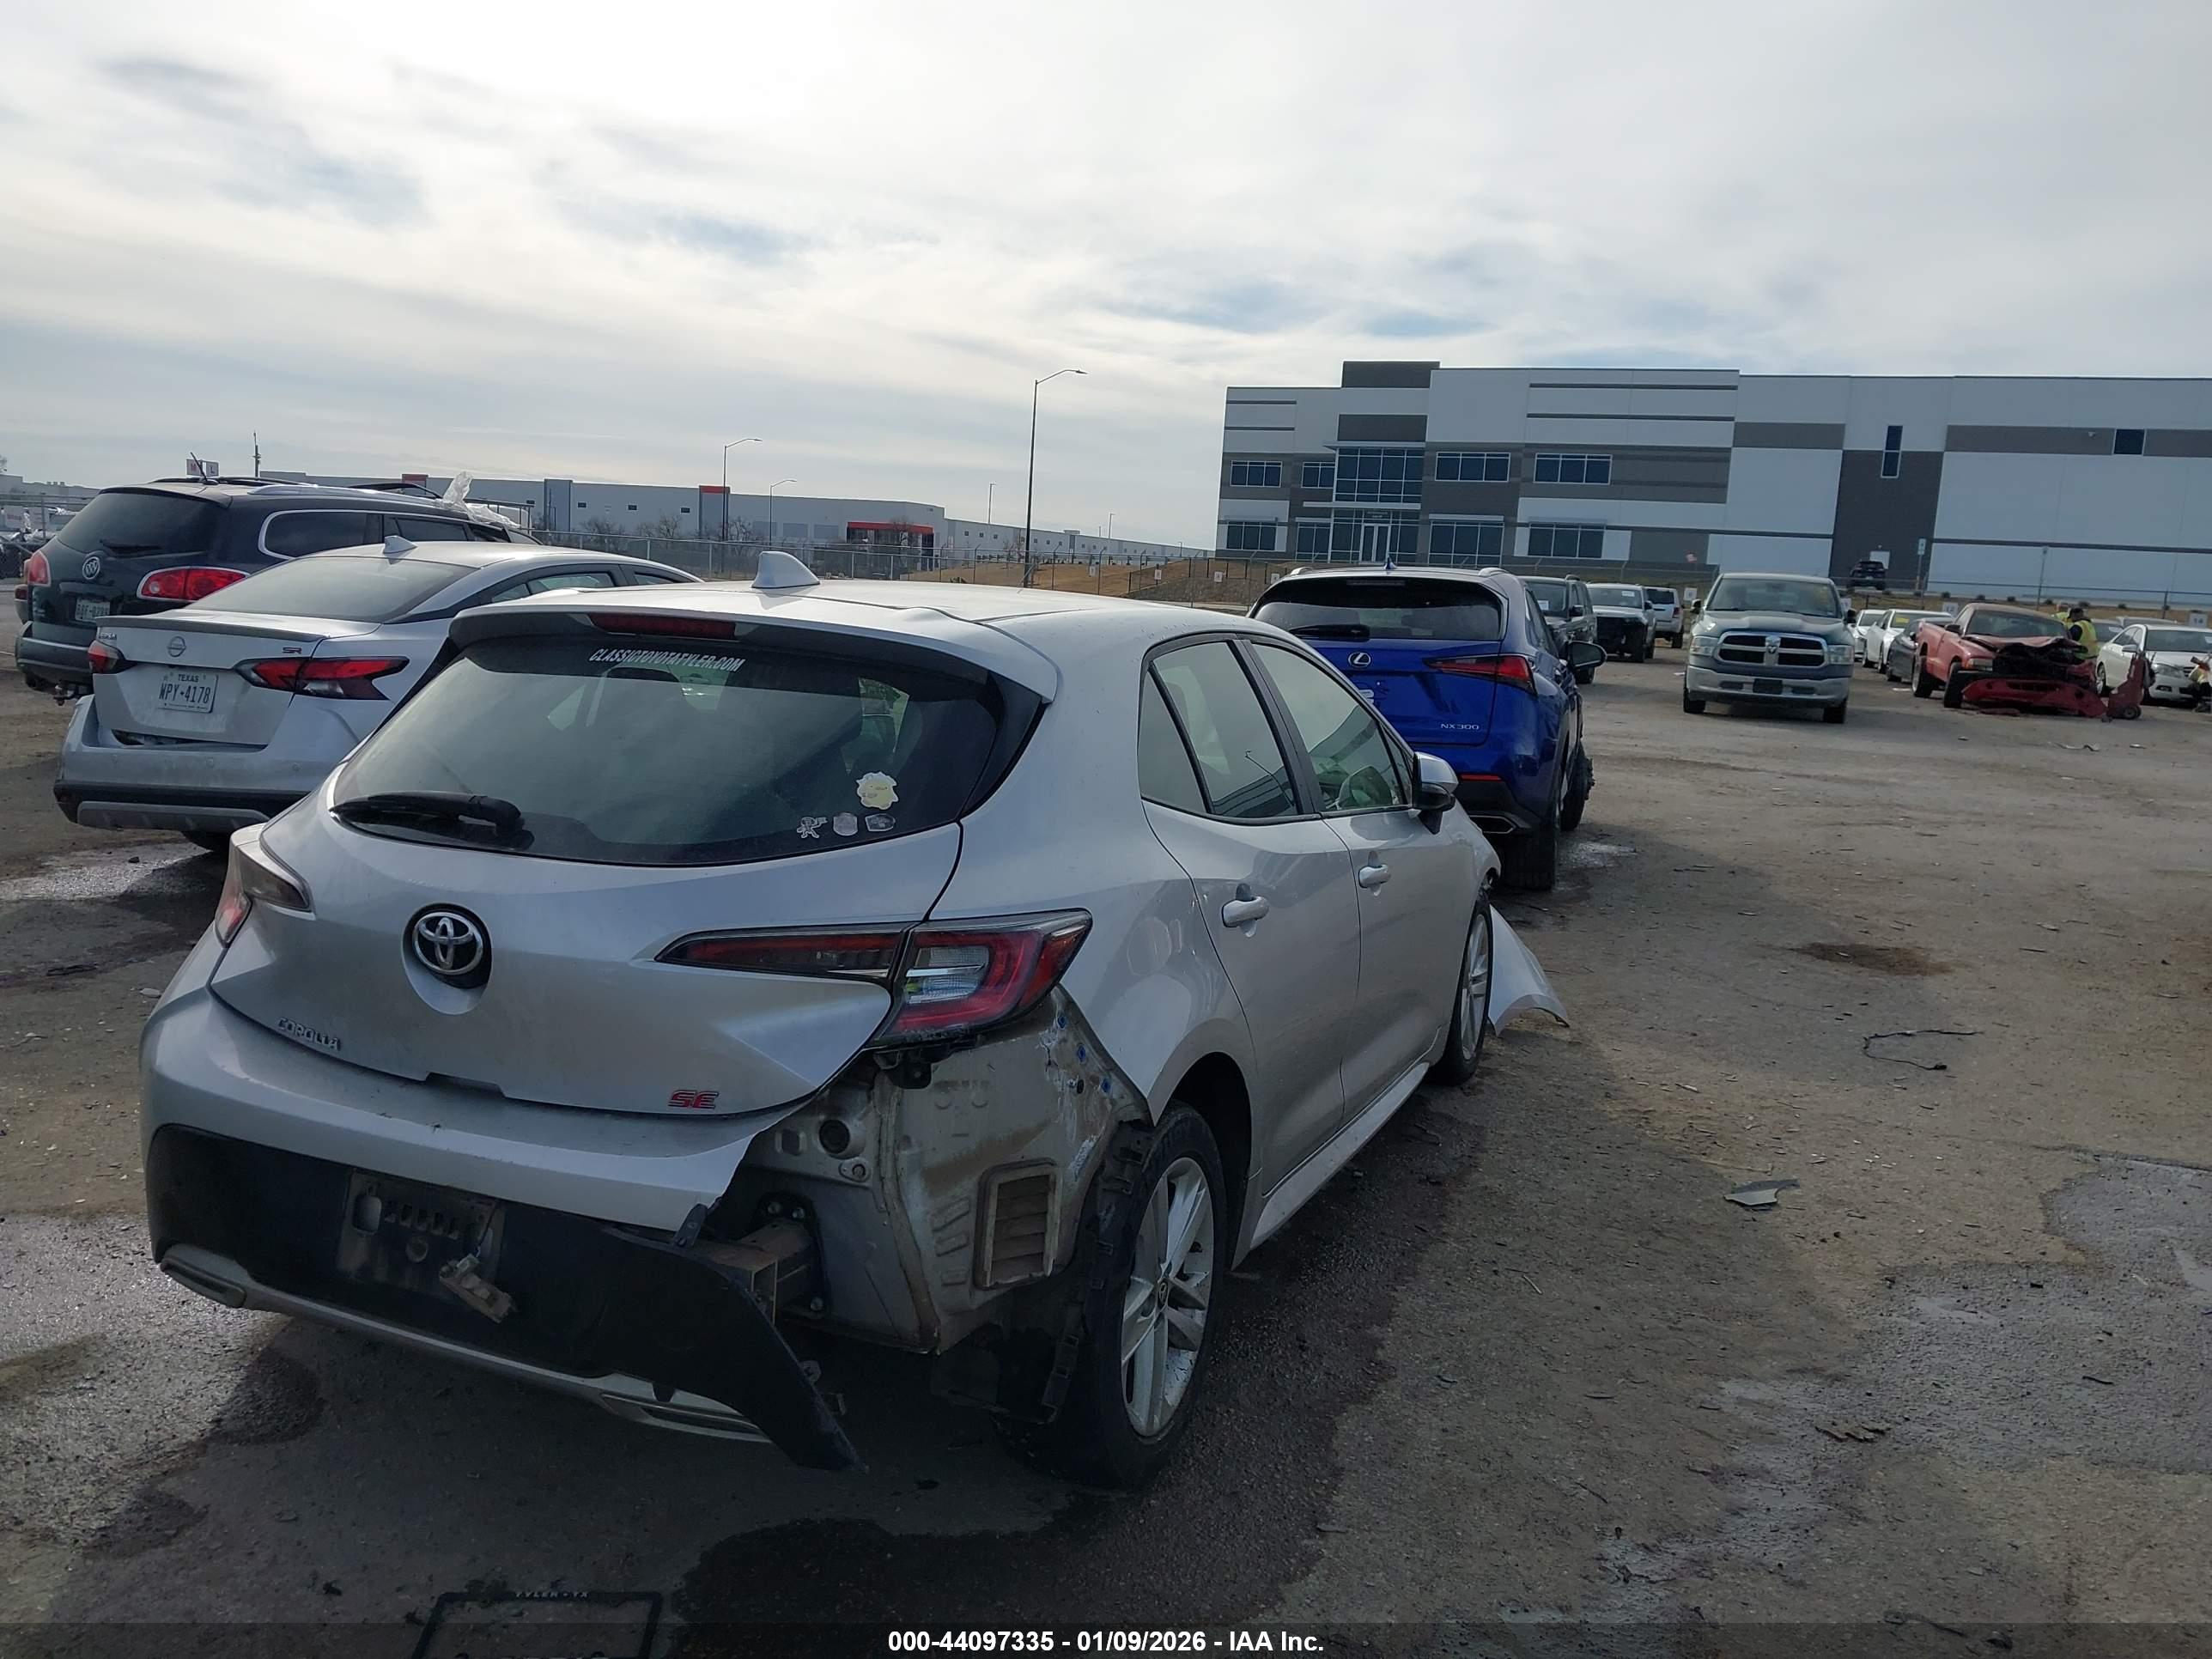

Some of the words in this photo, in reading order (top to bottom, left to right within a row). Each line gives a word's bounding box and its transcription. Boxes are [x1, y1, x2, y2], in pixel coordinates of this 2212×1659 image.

[589, 648, 746, 672] CLASSICTOYOTATYLER.COM
[178, 673, 199, 683] TEXAS
[277, 1017, 341, 1051] COROLLA
[667, 1090, 720, 1109] SE
